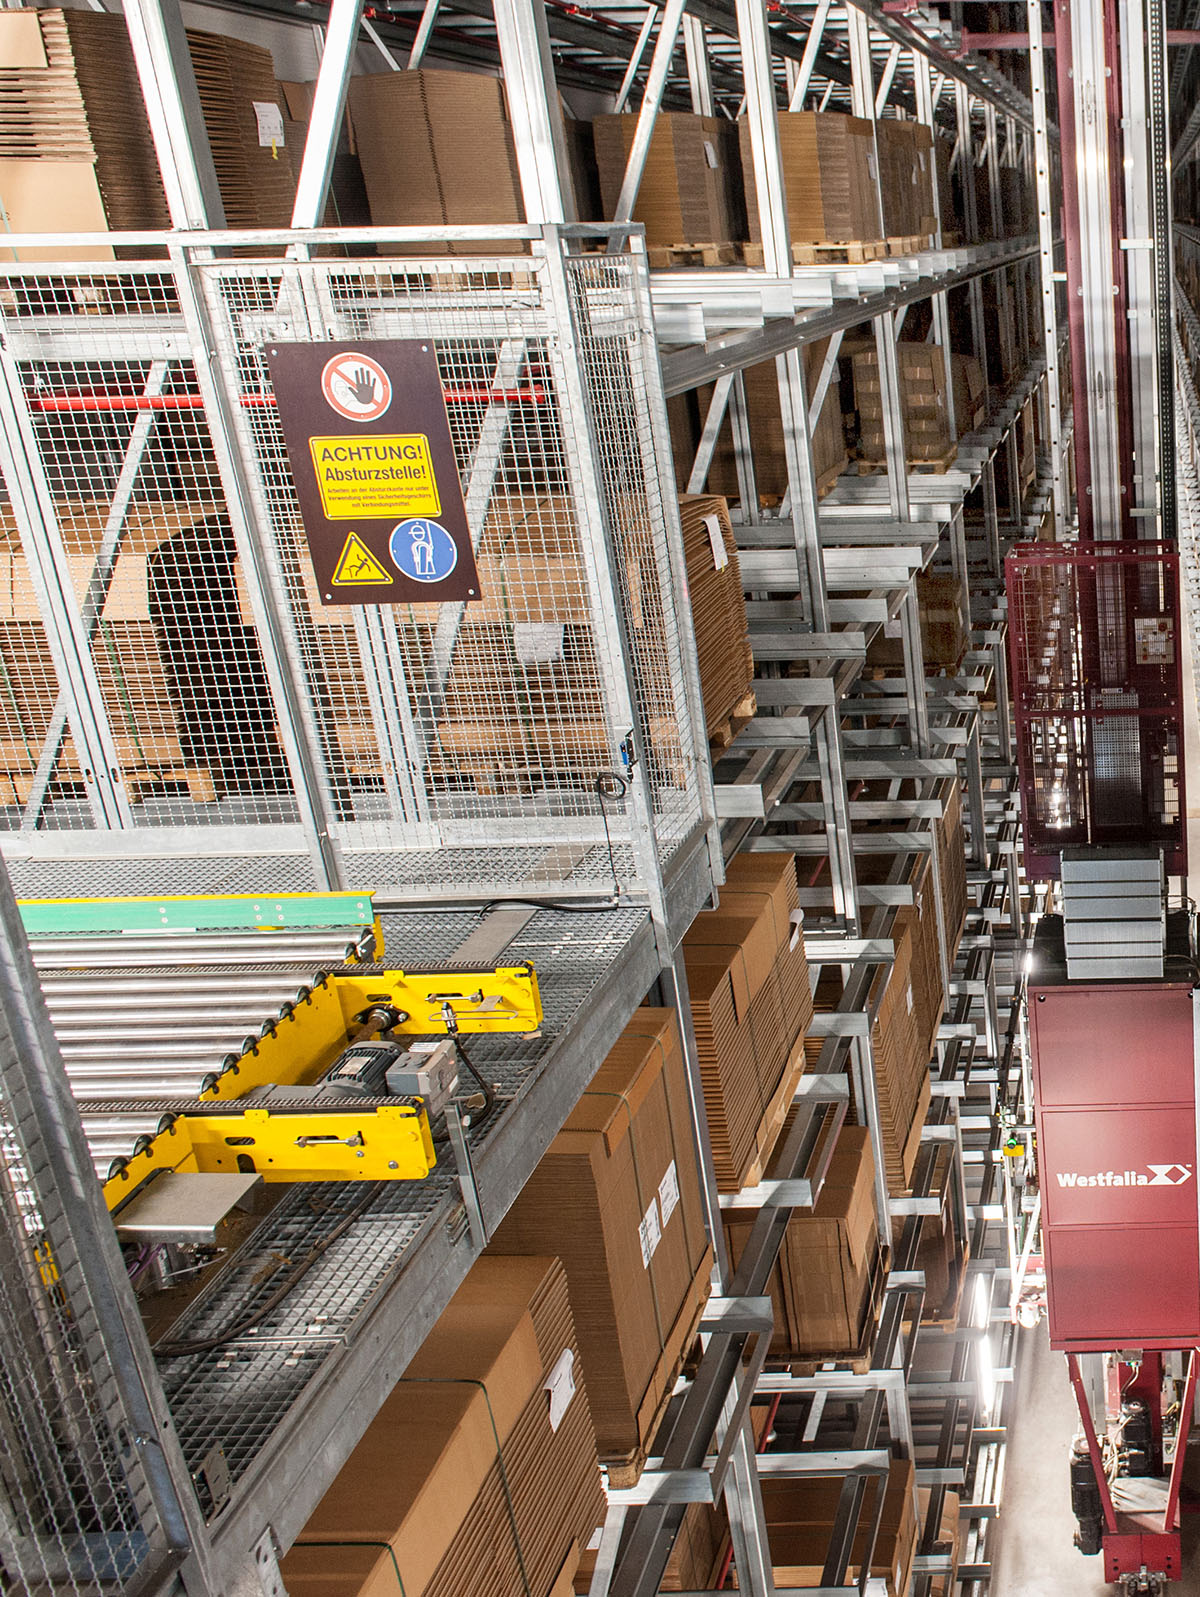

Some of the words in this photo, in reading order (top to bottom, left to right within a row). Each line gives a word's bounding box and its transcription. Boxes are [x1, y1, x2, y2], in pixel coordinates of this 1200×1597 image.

[321, 445, 423, 462] ACHTUNG!
[325, 465, 427, 481] Absturzstelle!
[1056, 1170, 1148, 1187] Westfalia
